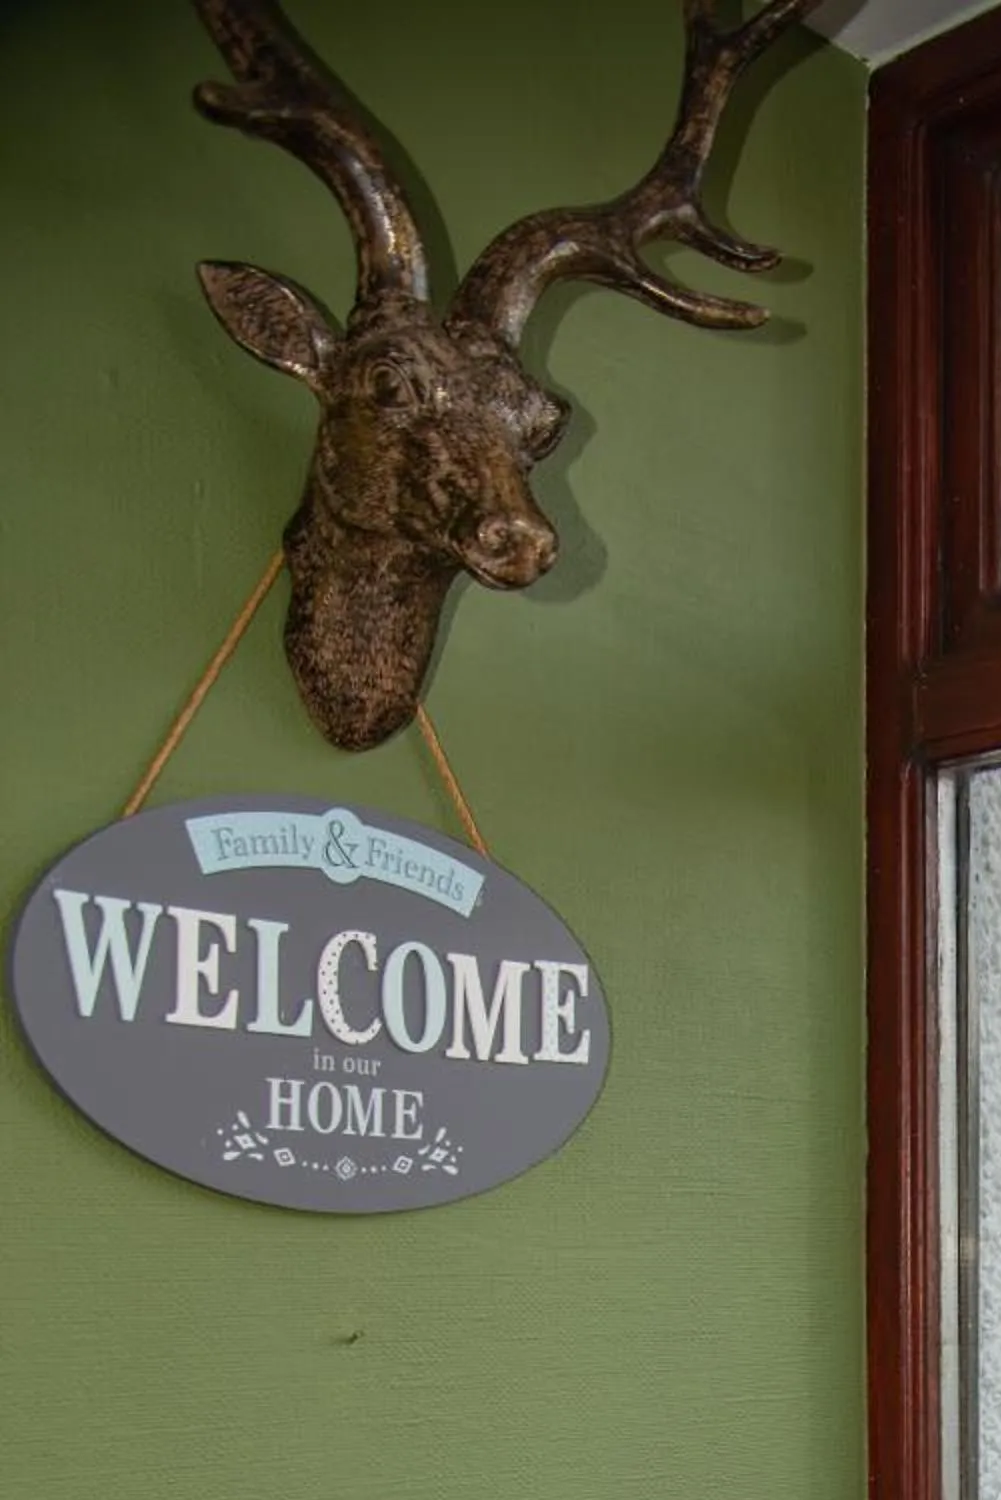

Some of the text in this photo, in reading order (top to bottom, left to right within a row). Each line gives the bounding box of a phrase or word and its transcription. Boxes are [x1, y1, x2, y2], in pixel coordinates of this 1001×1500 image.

[211, 819, 466, 902] Family & Friends
[53, 889, 590, 1064] WELCOME
[312, 1048, 382, 1076] in our
[265, 1077, 424, 1140] HOME
